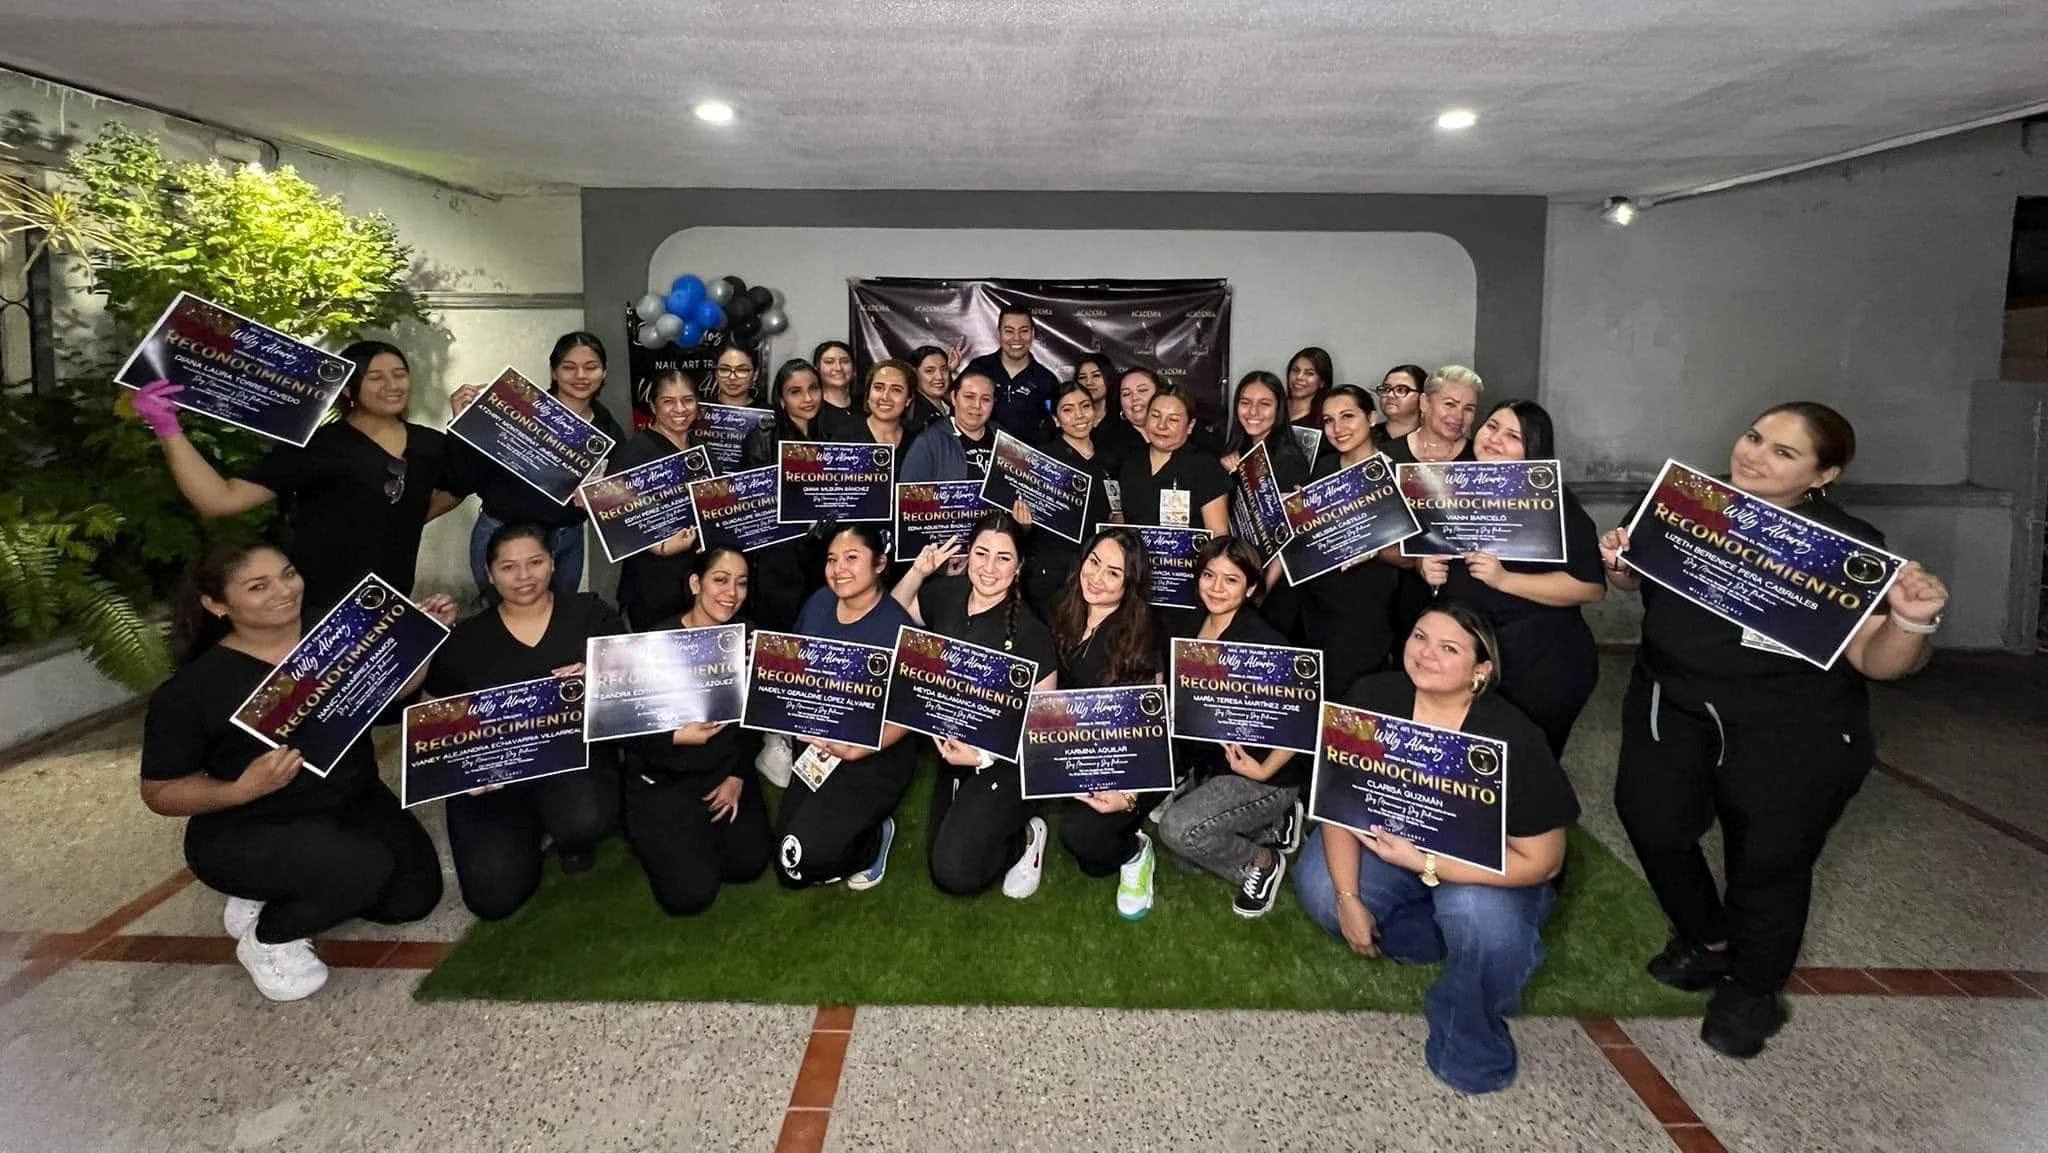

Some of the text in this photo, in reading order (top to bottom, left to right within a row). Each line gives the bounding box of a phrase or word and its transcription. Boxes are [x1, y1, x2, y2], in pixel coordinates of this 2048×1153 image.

[160, 328, 330, 402] RECONOCIMIENTO
[173, 353, 204, 369] DIANA
[202, 364, 233, 379] LAURA
[234, 376, 268, 393] TORRES
[268, 389, 301, 405] OVIEDO
[655, 361, 678, 370] NAIL
[682, 360, 700, 368] ART
[485, 391, 593, 470] RECONOCIMIENTO
[785, 471, 888, 481] RECONOCIMIENTO
[995, 456, 1083, 507] RECONOCIMIENTO
[598, 481, 686, 522] RECONOCIMIE
[701, 493, 778, 520] RECONOCIMI
[1294, 483, 1394, 535] CONOCIMIENTO
[1407, 497, 1554, 509] RECONOCIMIENTO
[1311, 525, 1337, 540] MELISSA
[1337, 511, 1367, 528] CASTILLO
[1718, 502, 1761, 534] Willy
[1745, 502, 1808, 533] NAIL ART TRAINER
[1652, 500, 1864, 614] RECONOCIMIENTO
[1663, 531, 1693, 550] LIZETH
[1693, 545, 1737, 571] BERENICE
[1736, 566, 1764, 584] PEÑA
[1764, 579, 1819, 610] CABRIALES
[273, 600, 407, 740] RECONOCIMIENTO
[288, 653, 323, 684] Willy
[316, 691, 343, 719] NANCY
[368, 635, 395, 663] RAMOS
[1218, 653, 1241, 670] Willy
[600, 690, 631, 700] SANDRA
[756, 665, 883, 697] RECONOCIMIENTO
[758, 685, 785, 695] NAIDELY
[786, 689, 822, 700] GERALDINE
[898, 661, 1023, 710] RECONOCIMIENTO
[912, 684, 935, 696] MEYDA
[936, 691, 976, 708] SALAMANCA
[1180, 674, 1316, 700] RECONOCIMIENTO
[468, 699, 496, 719] Willy
[1216, 696, 1243, 705] TERESA
[414, 706, 581, 754] RECONOCIMIENTO
[1027, 724, 1163, 744] RECONOCIMIENTO
[1373, 727, 1400, 752] Willy
[411, 755, 440, 767] VIANEY
[443, 744, 488, 759] ALEJANDRA
[1325, 745, 1495, 806] RECONOCIMIENTO
[1366, 779, 1401, 795] CLARISA
[1403, 788, 1443, 807] GUZMÁN
